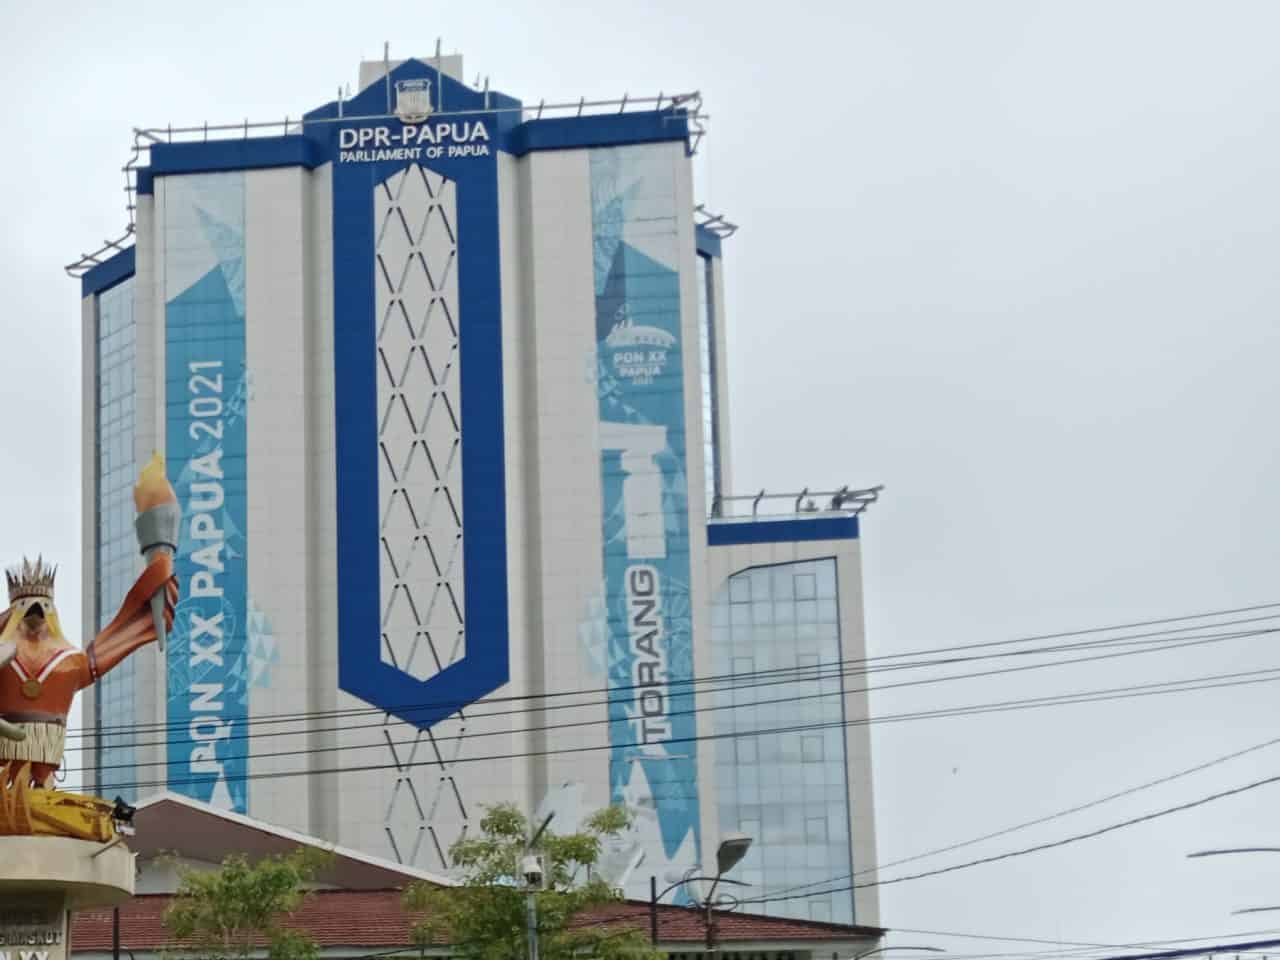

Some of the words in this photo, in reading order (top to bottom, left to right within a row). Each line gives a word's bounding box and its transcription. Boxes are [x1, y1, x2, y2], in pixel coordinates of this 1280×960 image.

[339, 122, 489, 149] DPR-PAPUA
[340, 147, 421, 163] PARLIAMENT
[426, 146, 444, 159] OF
[448, 145, 489, 158] PAPUA
[189, 360, 223, 441] 2021
[190, 449, 224, 598] PAPUA
[190, 615, 224, 666] XX
[631, 568, 665, 745] TORANG
[190, 683, 224, 774] PON
